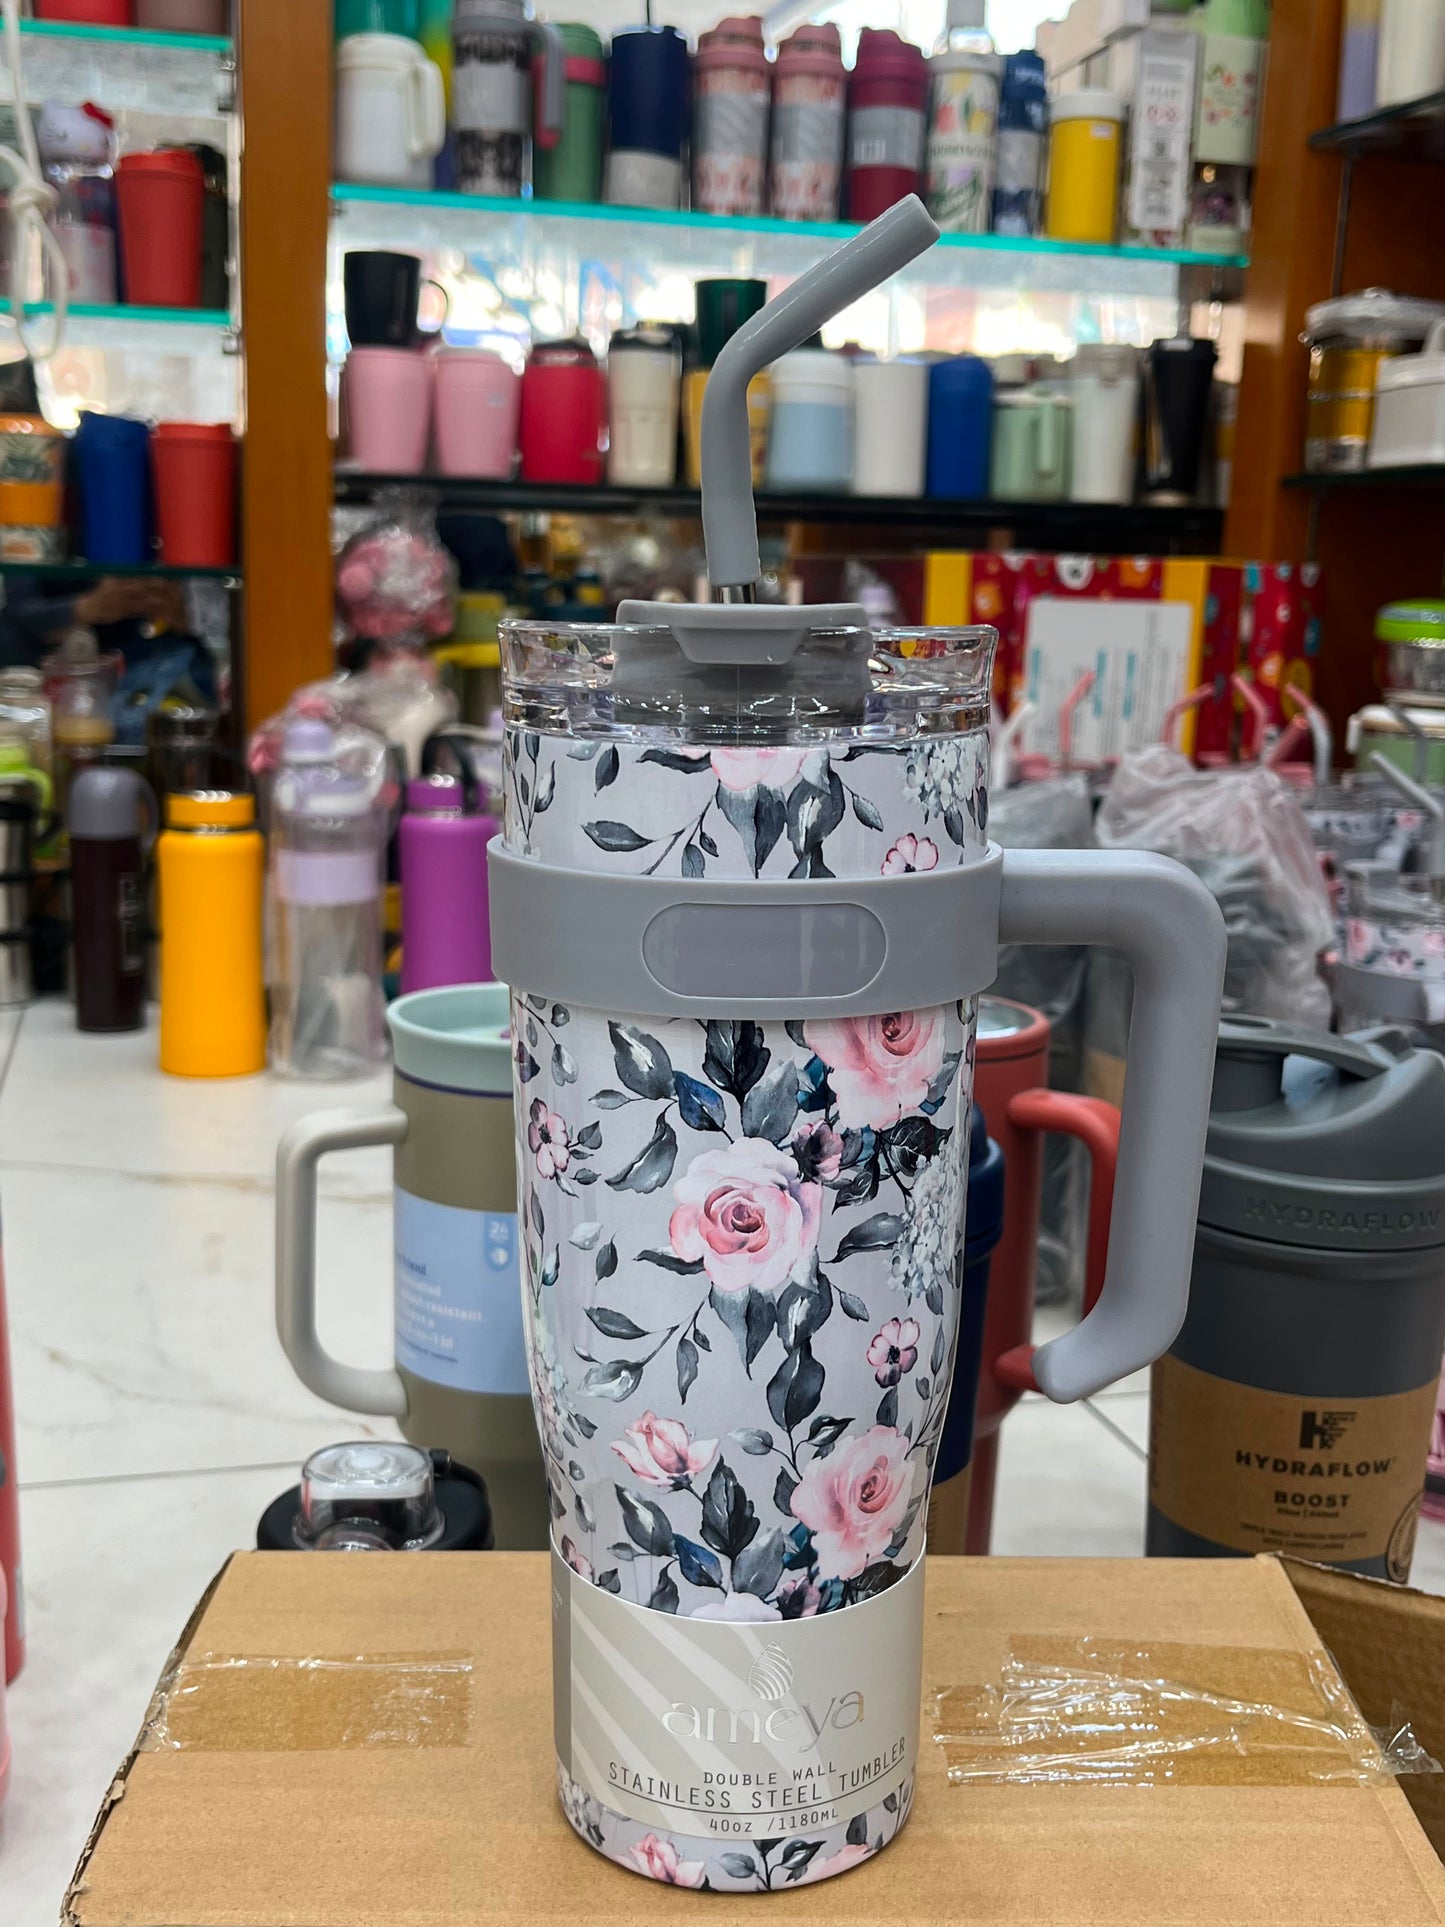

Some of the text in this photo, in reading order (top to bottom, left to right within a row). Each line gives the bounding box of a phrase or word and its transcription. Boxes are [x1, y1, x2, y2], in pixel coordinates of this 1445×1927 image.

[1245, 1197, 1441, 1233] HYDRAFLOW
[1235, 1450, 1392, 1478] HYDRAFLOW
[1274, 1490, 1351, 1508] BOOST
[661, 1691, 866, 1753] ameya
[608, 1736, 906, 1809] STAINLESS STEEL TUMBLER
[703, 1761, 837, 1786] DOUBLE WALL
